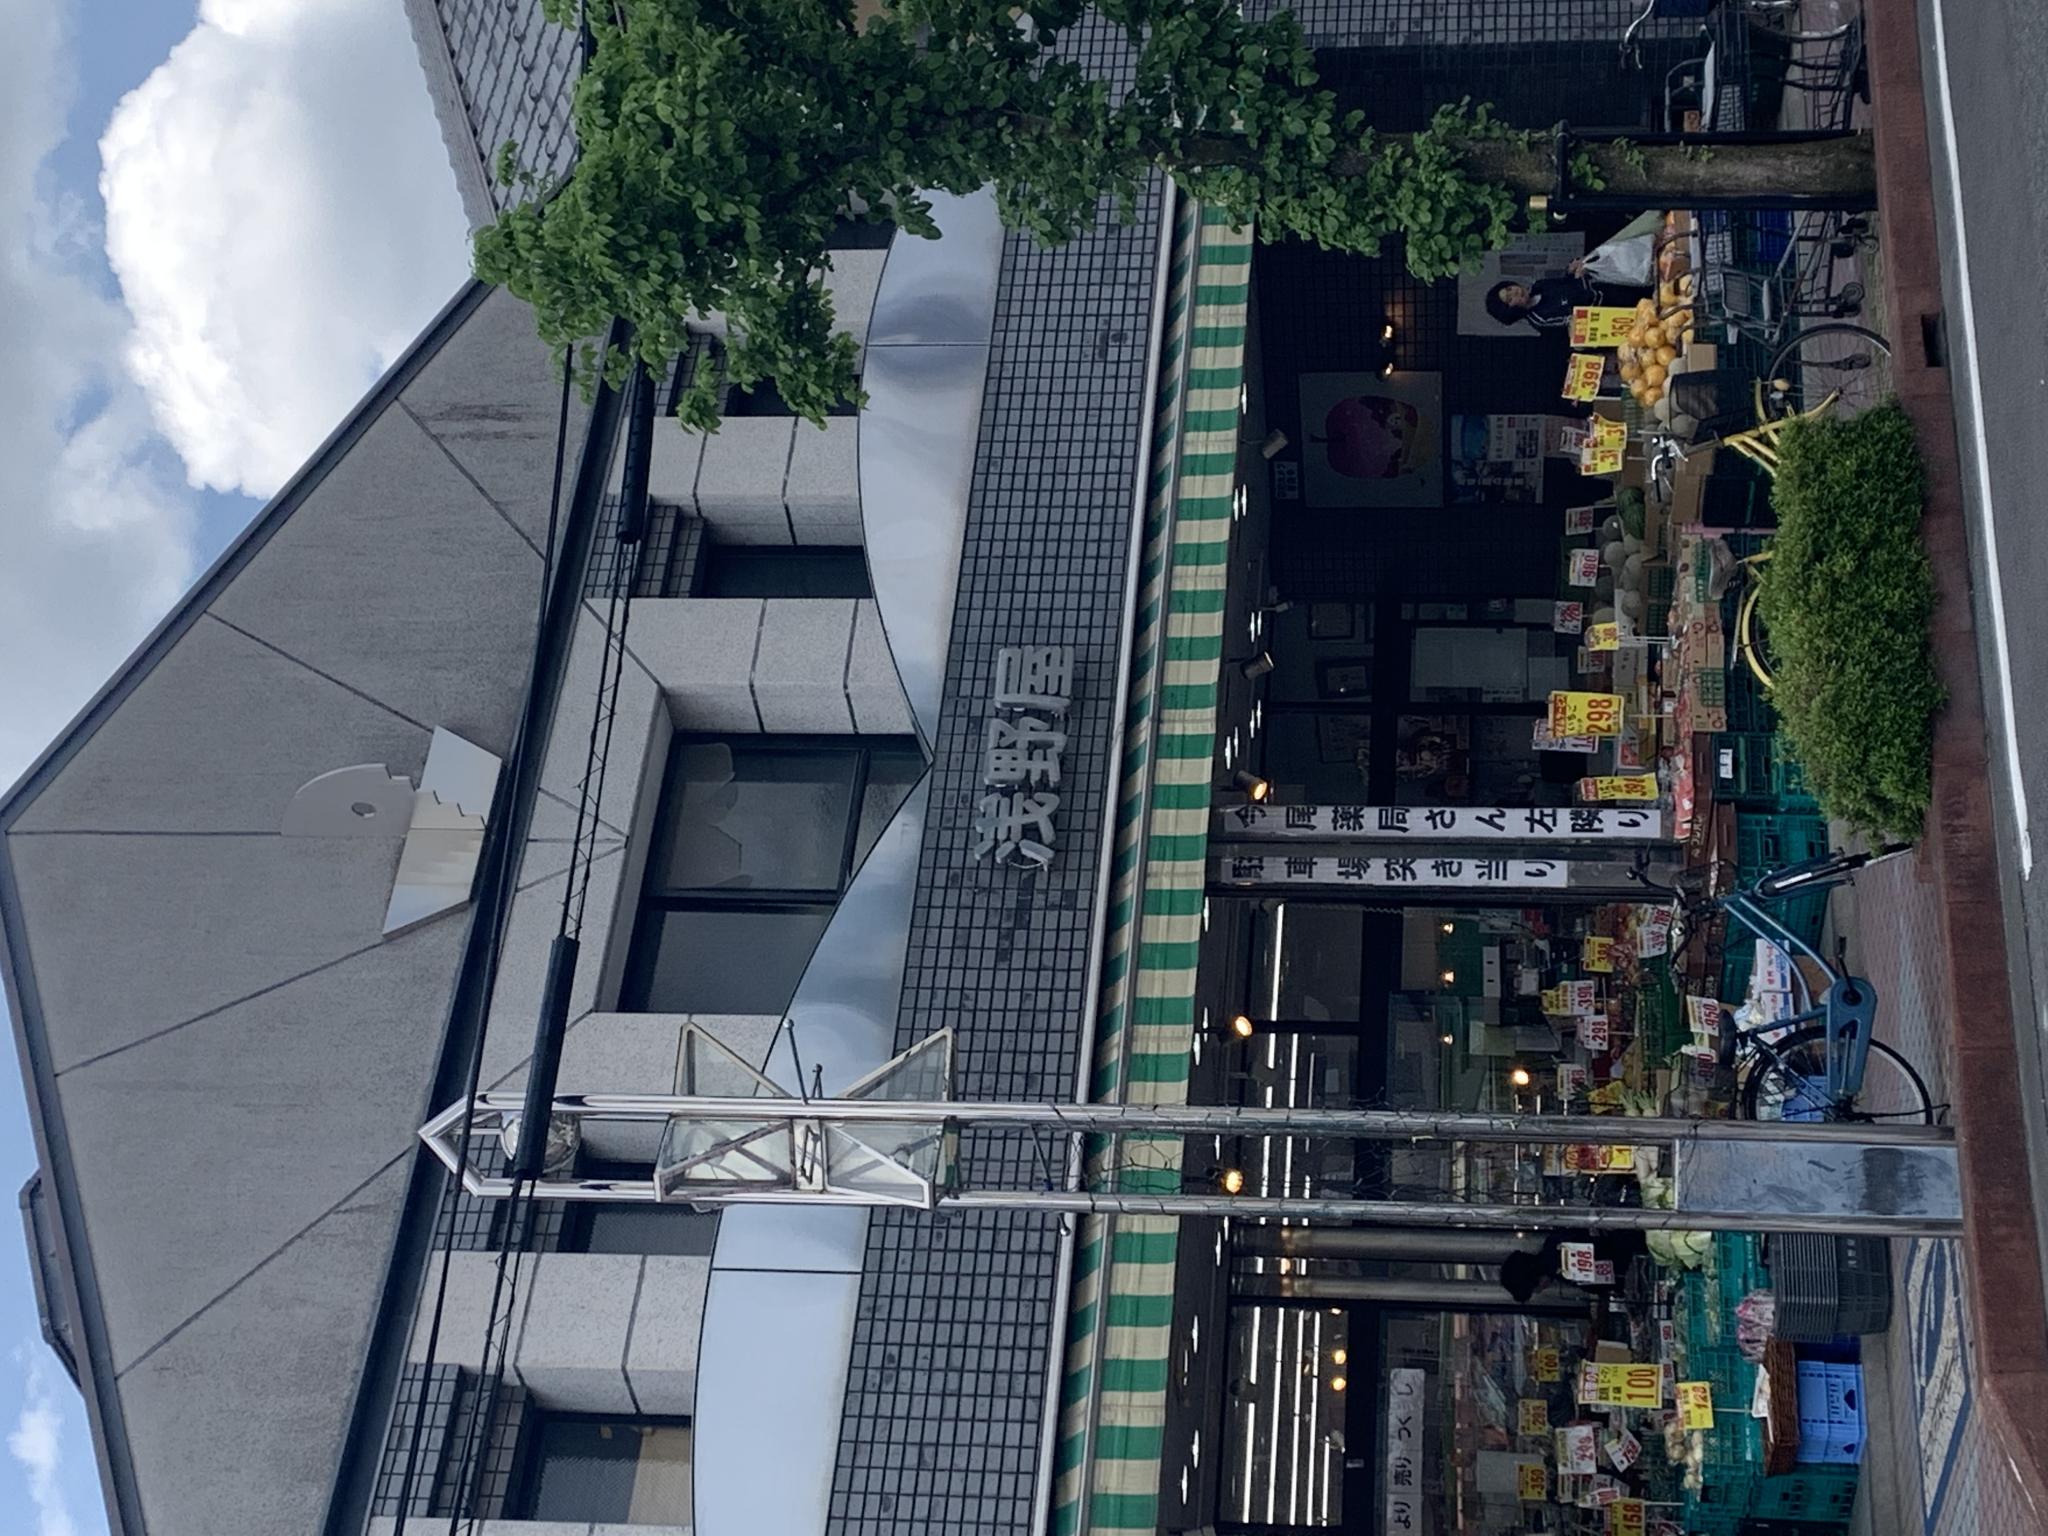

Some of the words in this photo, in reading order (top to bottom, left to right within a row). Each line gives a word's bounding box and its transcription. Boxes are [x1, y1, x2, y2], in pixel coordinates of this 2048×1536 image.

[1611, 316, 1635, 338] 350
[1581, 361, 1602, 390] 398
[1582, 555, 1598, 578] 980
[1585, 698, 1613, 734] 298
[973, 645, 1075, 866] 浅野屋
[1235, 805, 1650, 834] 今尾薬局さん左隣り
[1231, 856, 1556, 882] 駐車場突き当り
[1576, 1250, 1593, 1274] 198
[1626, 1368, 1656, 1401] 100
[1622, 1502, 1642, 1531] 158
